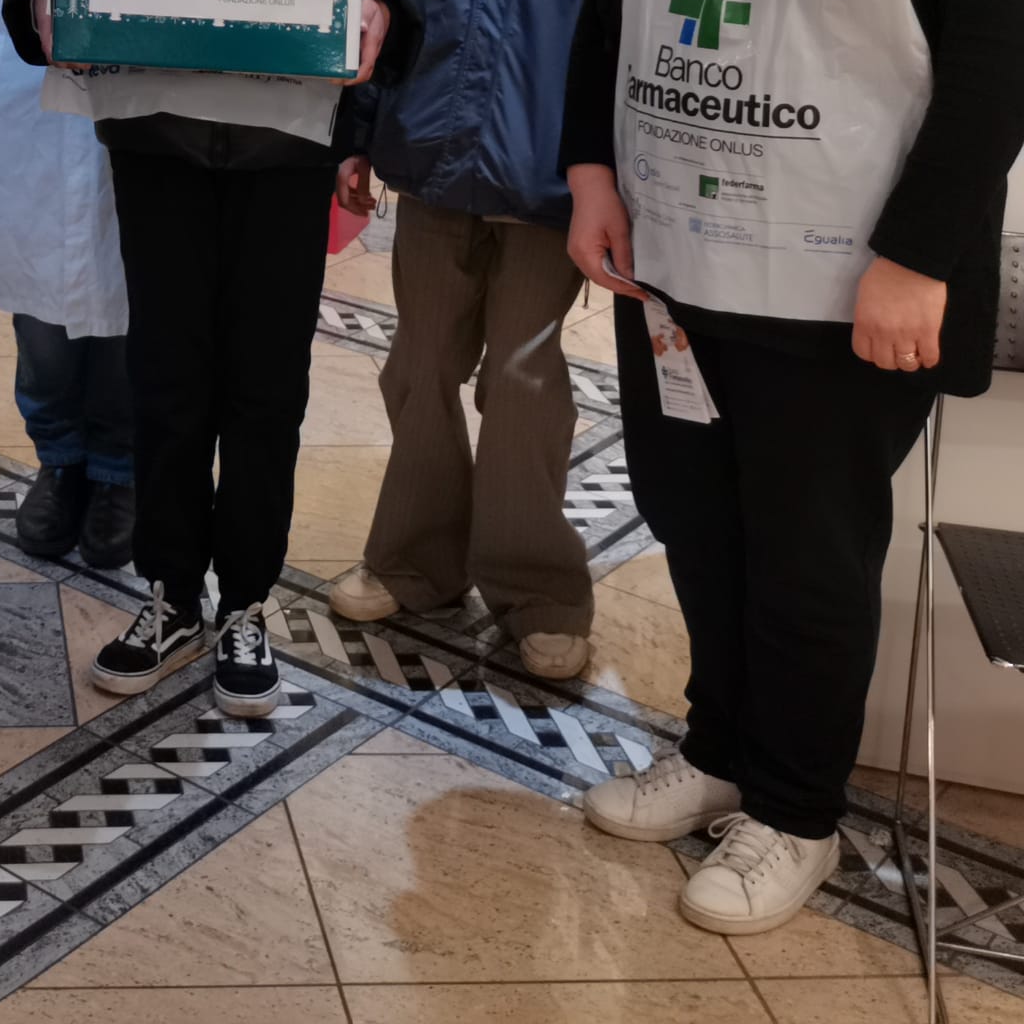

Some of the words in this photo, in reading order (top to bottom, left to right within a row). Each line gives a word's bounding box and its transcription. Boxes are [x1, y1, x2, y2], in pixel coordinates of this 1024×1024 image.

[654, 44, 744, 91] Banco
[628, 64, 821, 130] armaceutico
[638, 120, 708, 149] FONDAZIONE
[710, 138, 764, 157] ONLUS
[721, 177, 765, 192] federfarma
